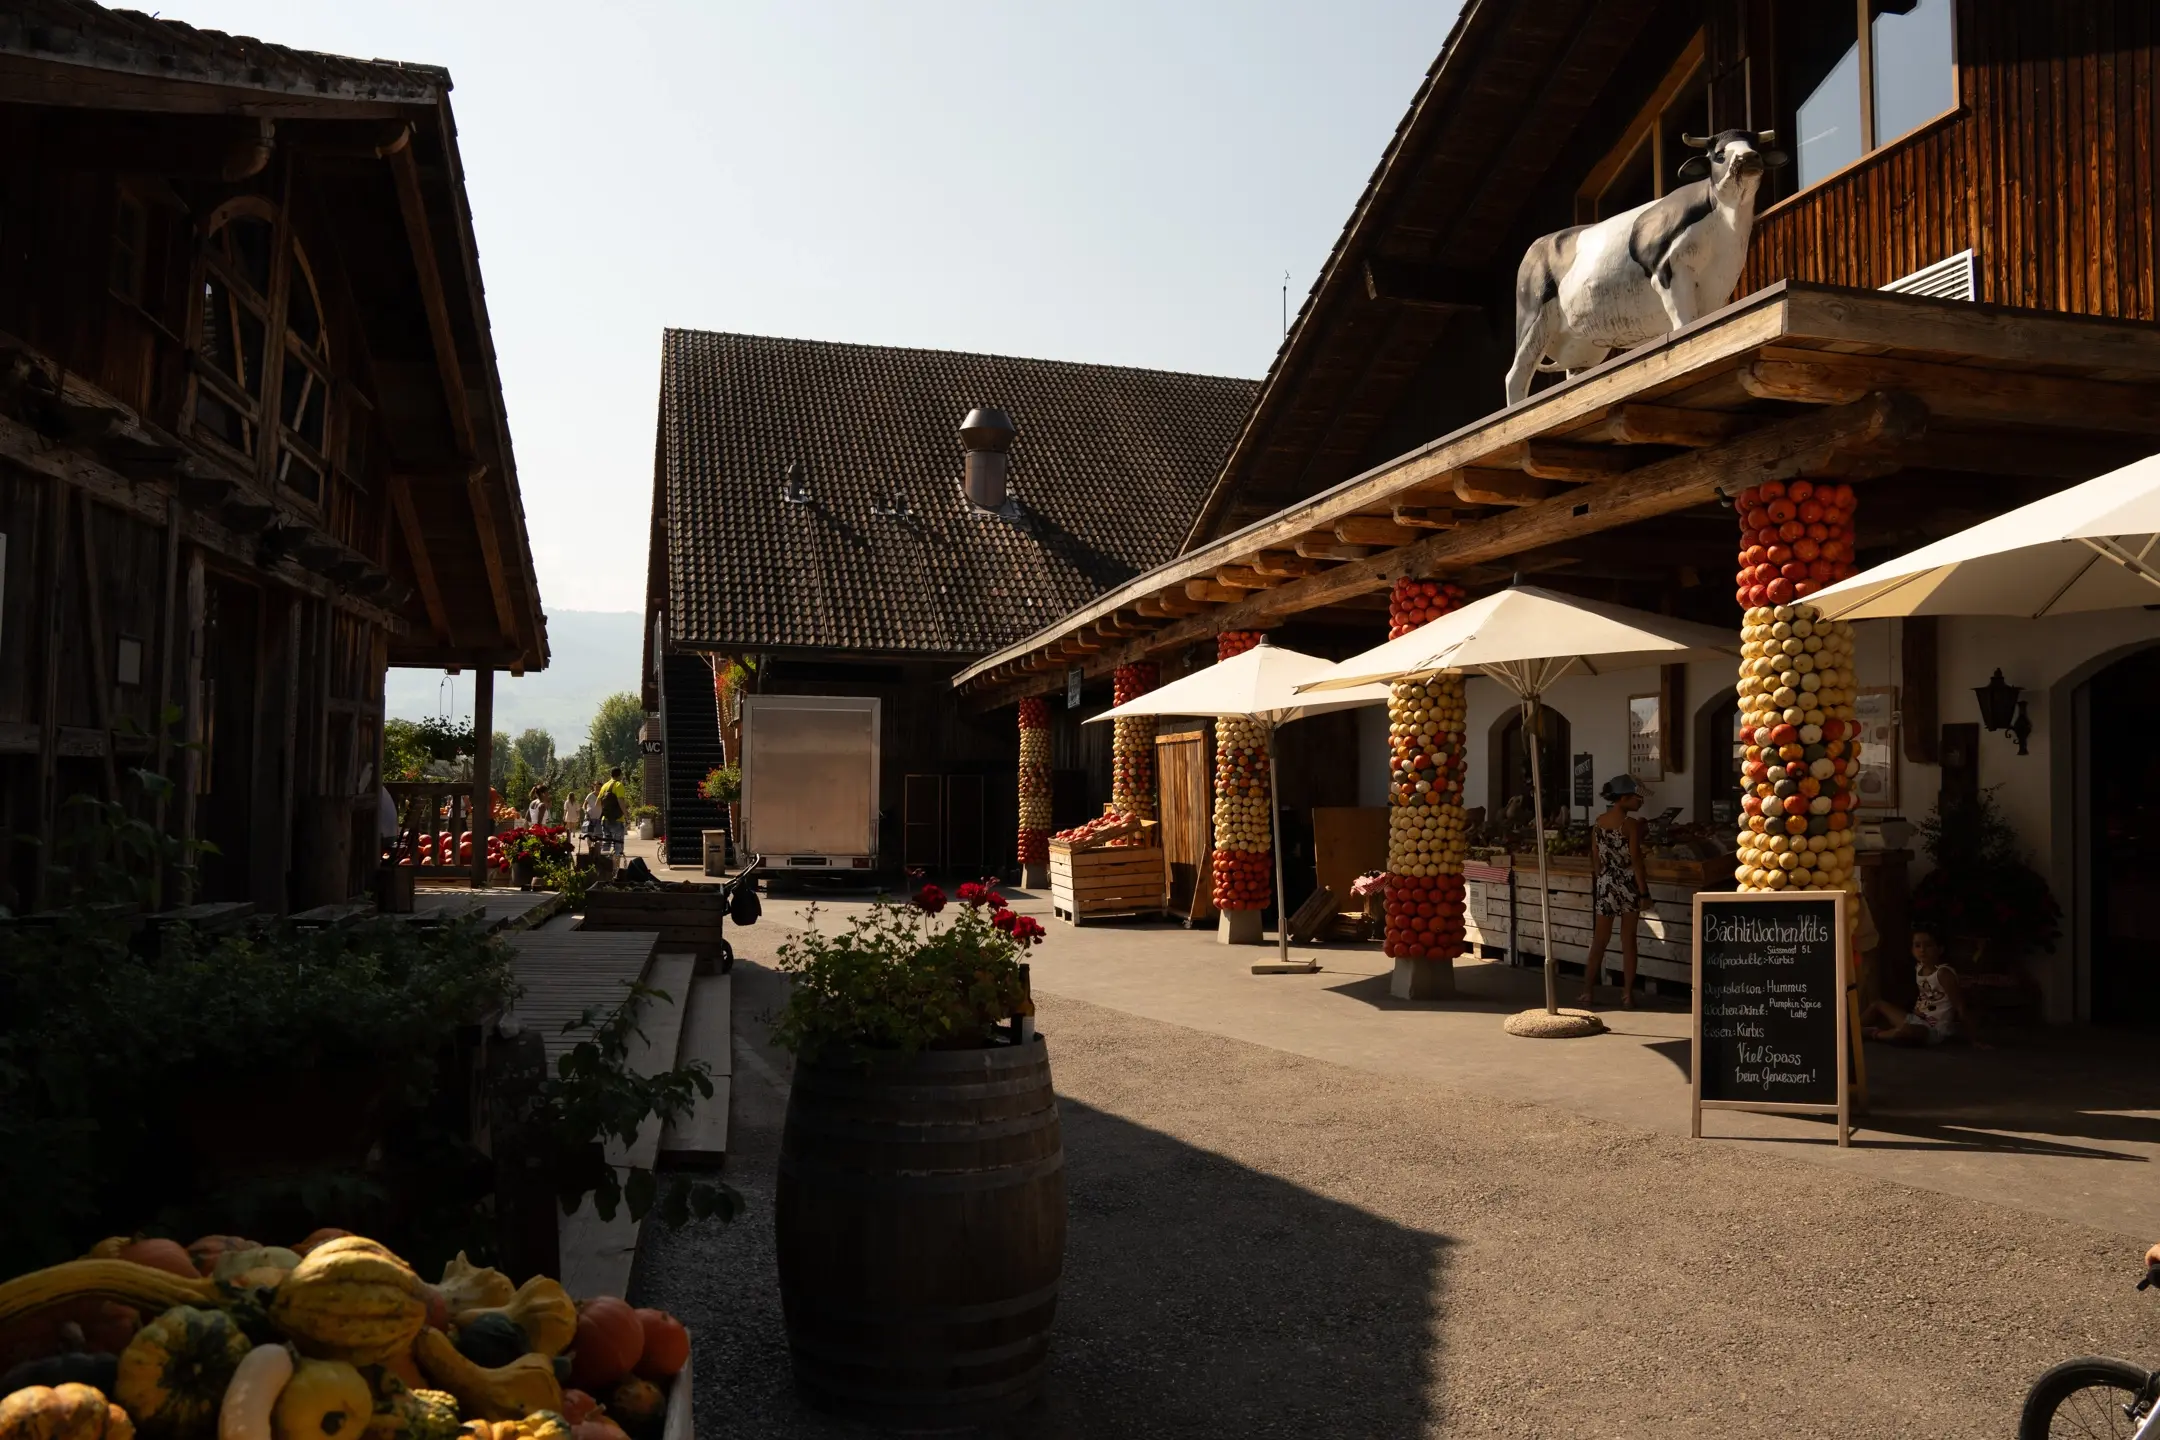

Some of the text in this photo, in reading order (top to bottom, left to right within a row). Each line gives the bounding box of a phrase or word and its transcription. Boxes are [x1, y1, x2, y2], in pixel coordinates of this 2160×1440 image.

[645, 741, 661, 753] WC
[1766, 980, 1807, 993] Hummus
[1769, 997, 1822, 1010] Pumpkin Spice
[1790, 1009, 1808, 1019] Latte
[1737, 1042, 1801, 1068] Viel Spass
[1735, 1066, 1760, 1083] beim
